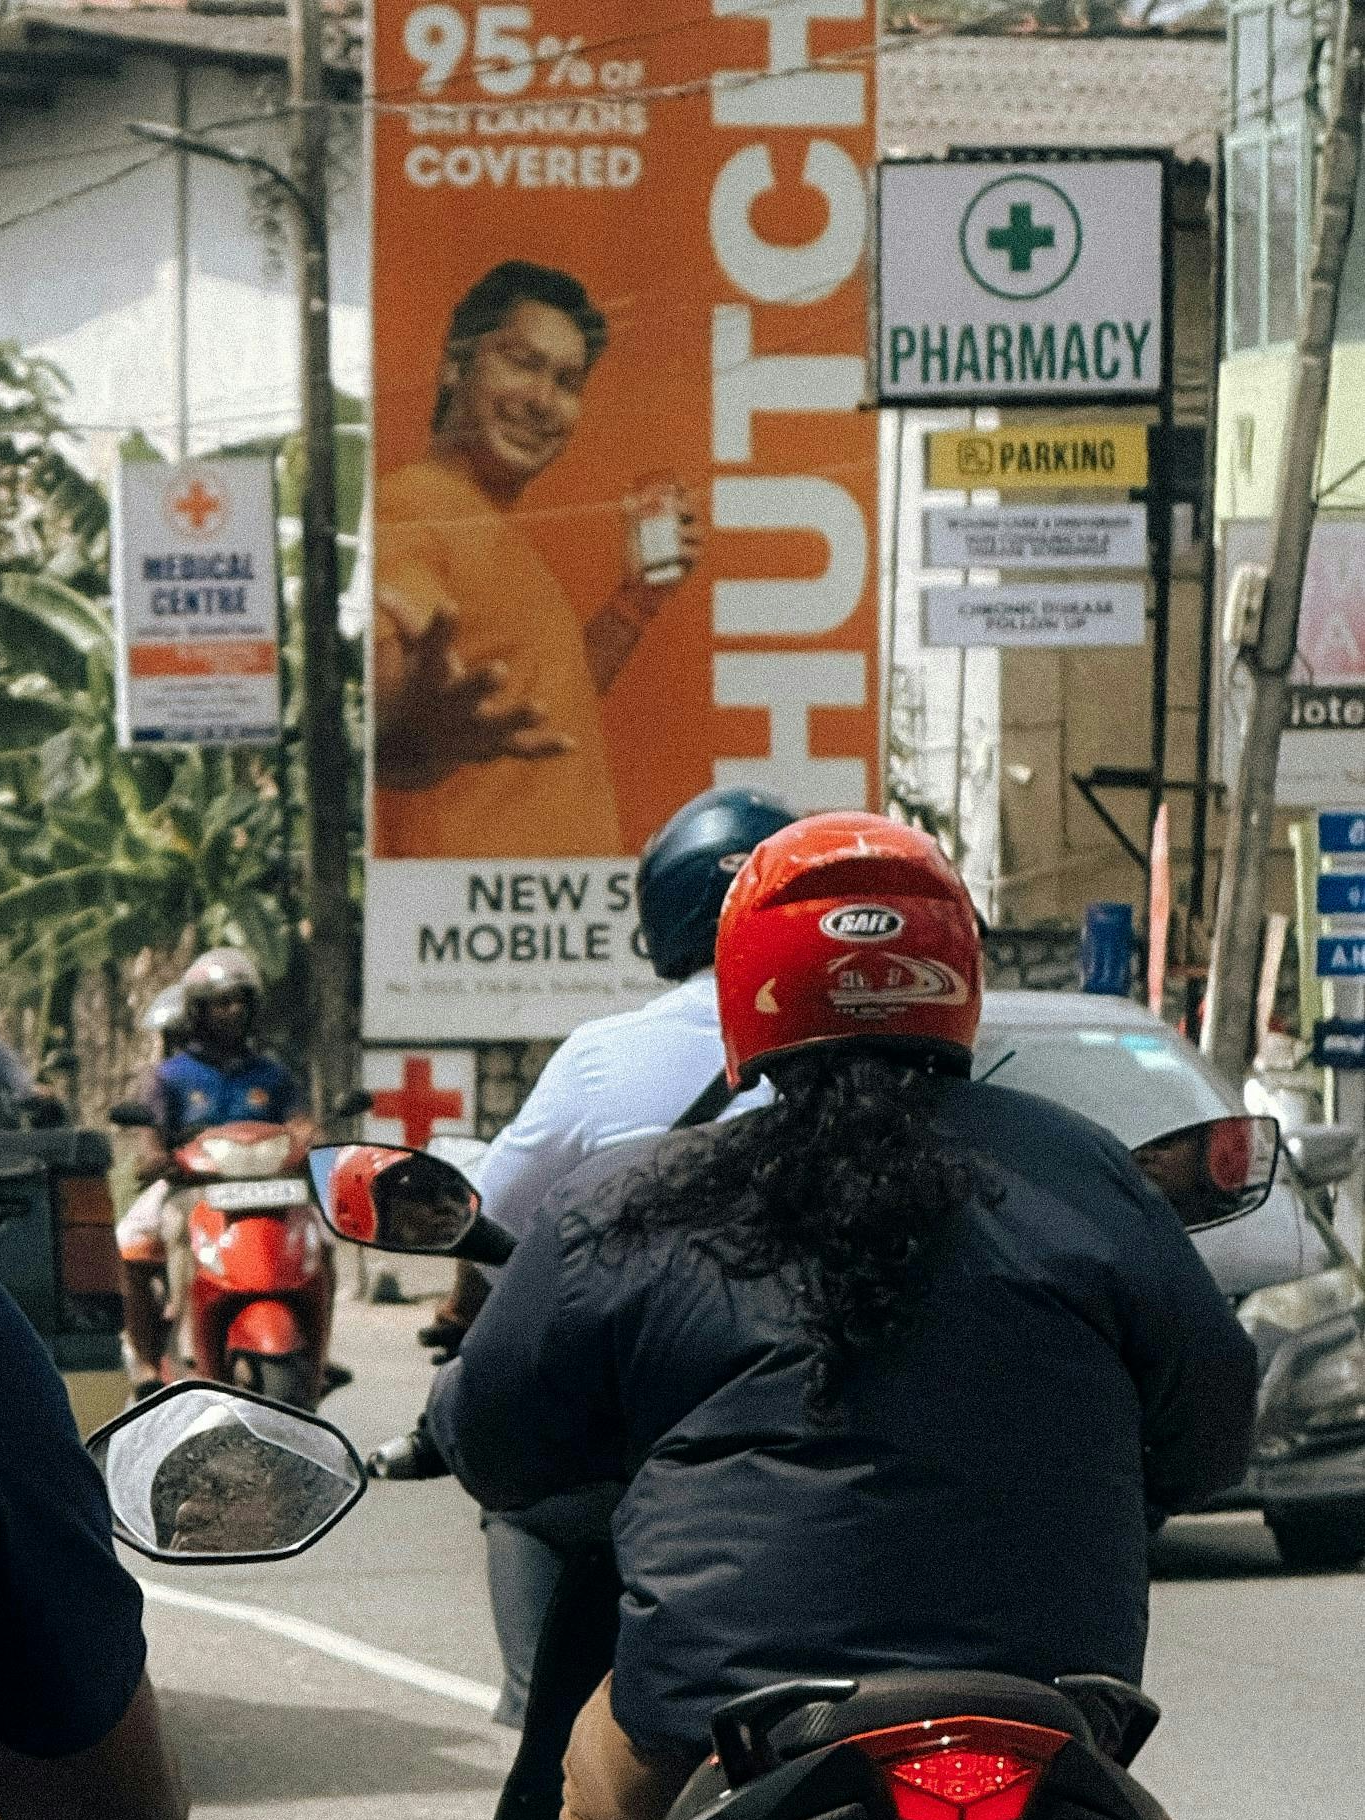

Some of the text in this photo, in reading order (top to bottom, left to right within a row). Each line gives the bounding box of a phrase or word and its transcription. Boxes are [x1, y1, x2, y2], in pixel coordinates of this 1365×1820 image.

[404, 145, 644, 189] COVERED
[888, 319, 1153, 385] PHARMACY
[711, 0, 869, 817] HUTCH
[1000, 439, 1116, 473] PARKING
[142, 553, 255, 581] MEDICAL
[151, 586, 246, 616] CENTRE
[468, 873, 589, 913] NEW
[418, 923, 611, 963] MOBILE
